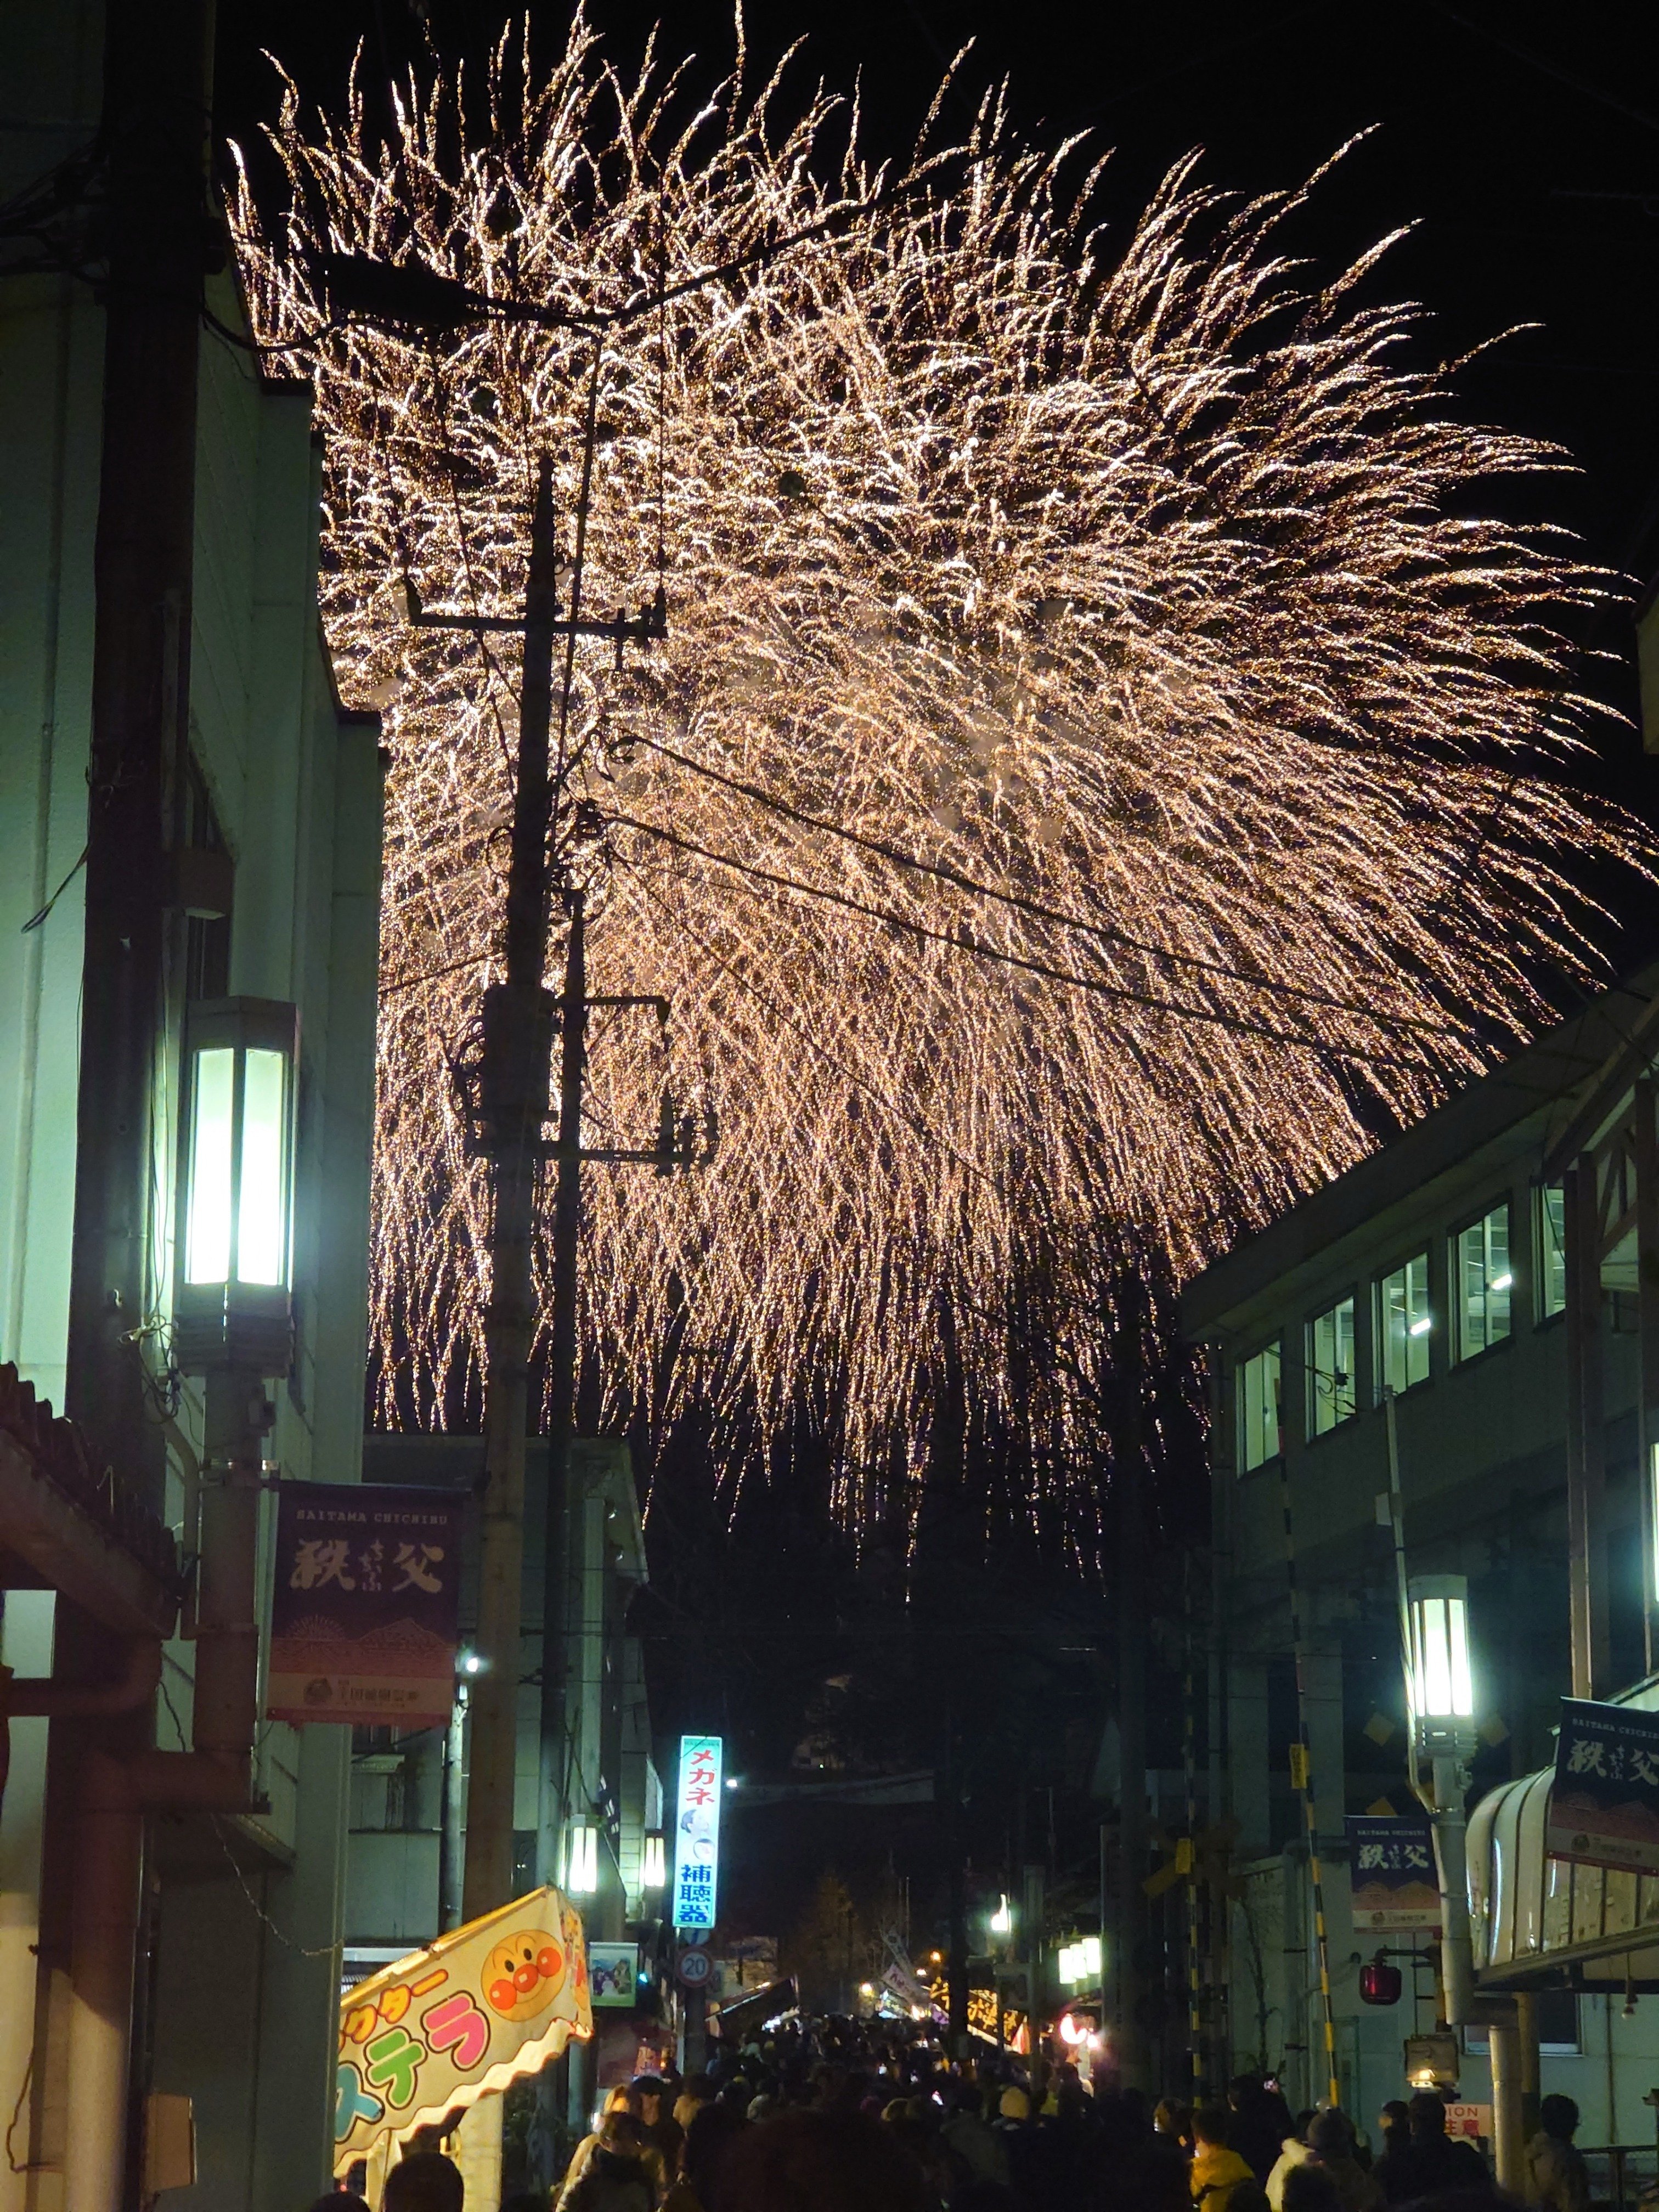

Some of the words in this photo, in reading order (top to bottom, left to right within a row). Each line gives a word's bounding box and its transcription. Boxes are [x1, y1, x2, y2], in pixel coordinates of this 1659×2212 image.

[296, 1510, 367, 1522] SAITAMA
[374, 1513, 448, 1525] CHICHIBU
[685, 1749, 718, 1805] メガネ
[679, 1864, 712, 1922] 補聴器
[685, 1957, 706, 1976] 20
[337, 1968, 449, 2056] クター
